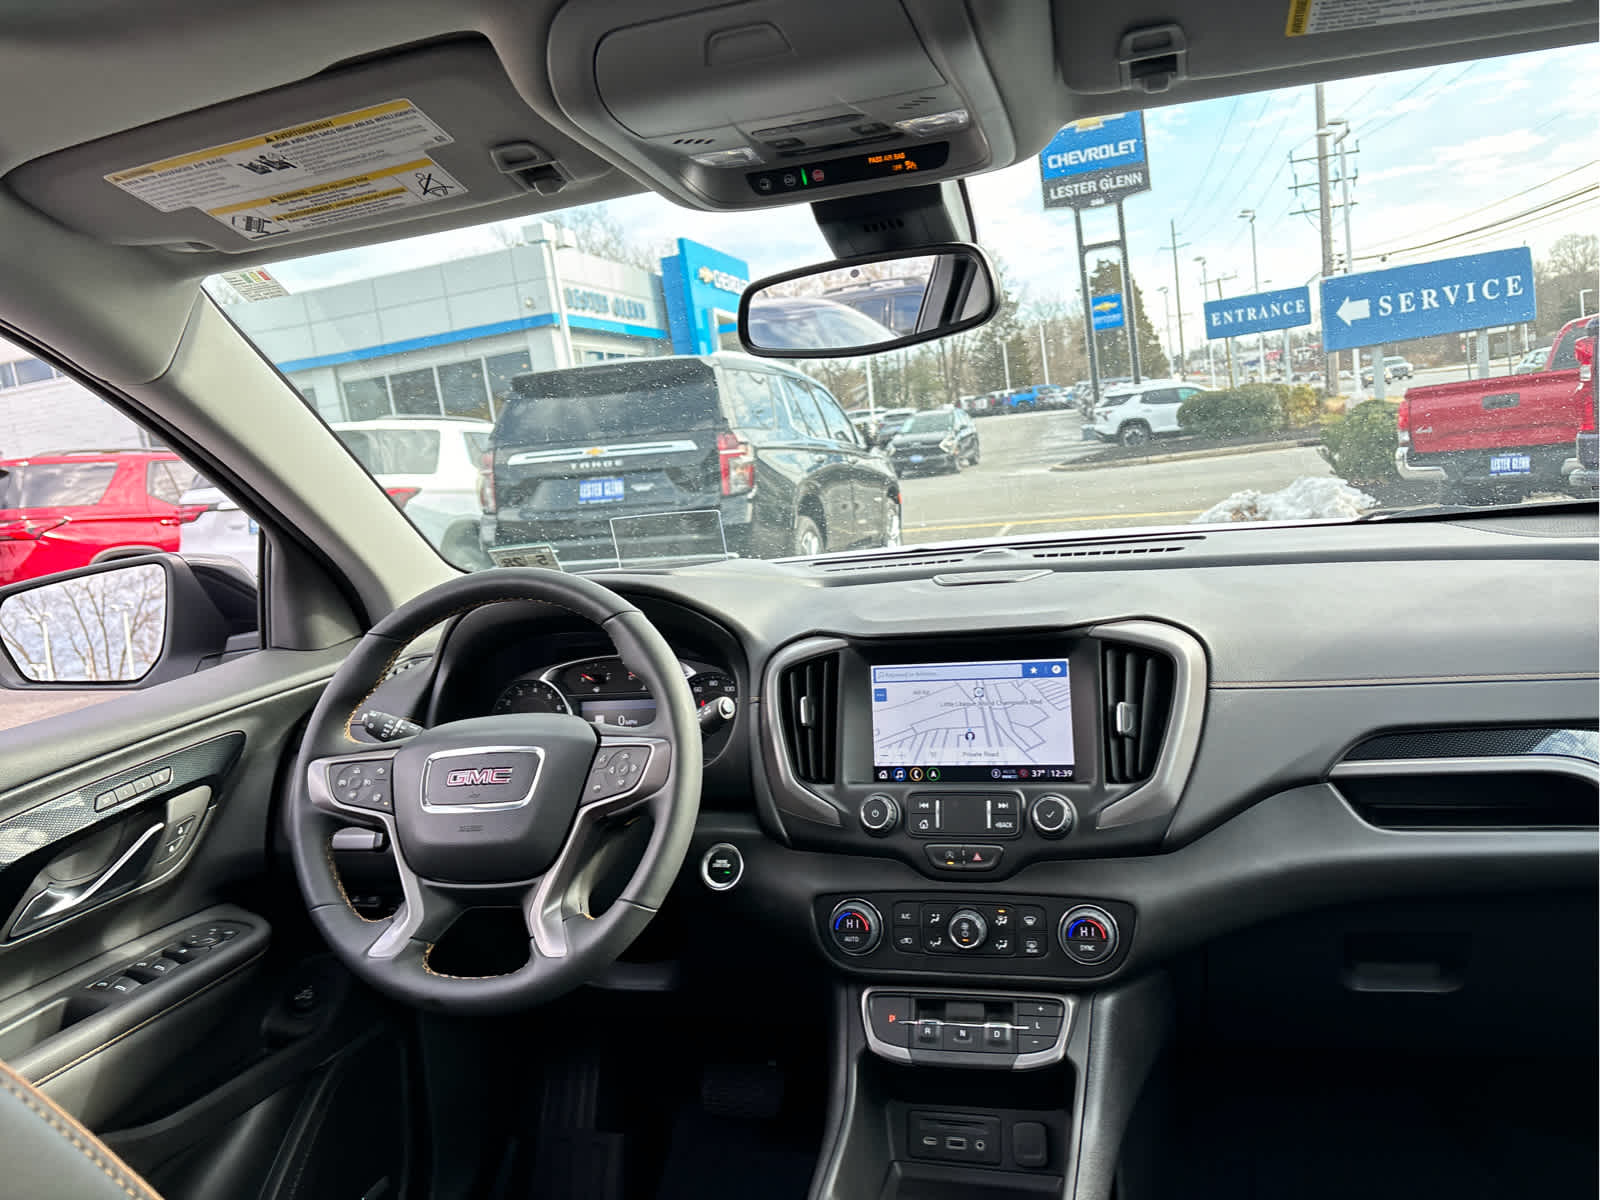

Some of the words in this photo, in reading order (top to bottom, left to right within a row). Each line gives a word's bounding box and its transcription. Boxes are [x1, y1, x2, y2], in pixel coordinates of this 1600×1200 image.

[1047, 139, 1137, 169] CHEVROLET
[868, 155, 882, 164] PASS
[1050, 180, 1097, 200] LESTER
[1099, 172, 1143, 192] GLENN
[1379, 275, 1524, 317] SERVICE
[1211, 300, 1305, 327] ENTRANCE
[570, 459, 623, 469] TAHOE
[618, 715, 624, 726] 0
[447, 768, 512, 787] GMC
[1051, 769, 1072, 777] 12:39
[846, 919, 860, 929] HI
[1080, 927, 1095, 937] HI
[844, 935, 860, 943] AUTO
[888, 1014, 896, 1023] P
[924, 1027, 931, 1035] R
